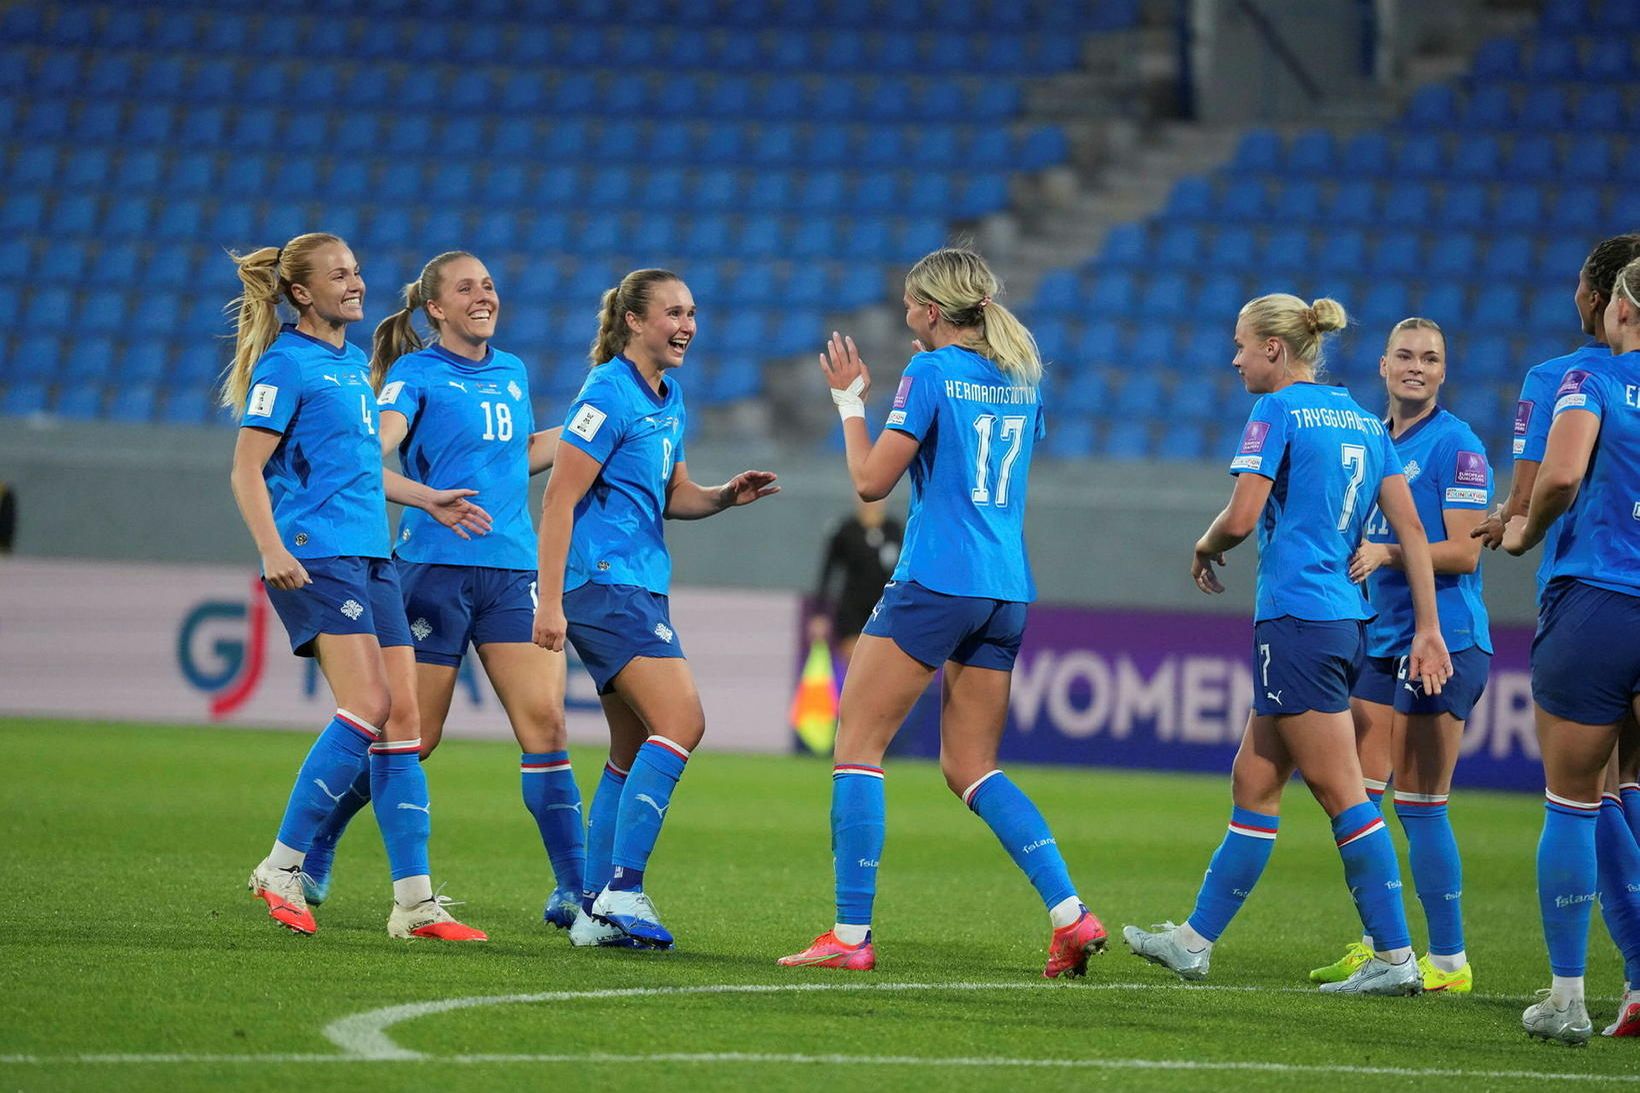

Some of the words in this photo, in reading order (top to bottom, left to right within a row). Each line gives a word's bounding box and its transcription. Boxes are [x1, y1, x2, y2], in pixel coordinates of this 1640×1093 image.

[361, 394, 375, 435] 4
[480, 401, 513, 442] 18
[662, 438, 673, 480] 8
[972, 414, 1027, 508] 17
[1337, 443, 1367, 533] 7
[1260, 643, 1271, 687] 7
